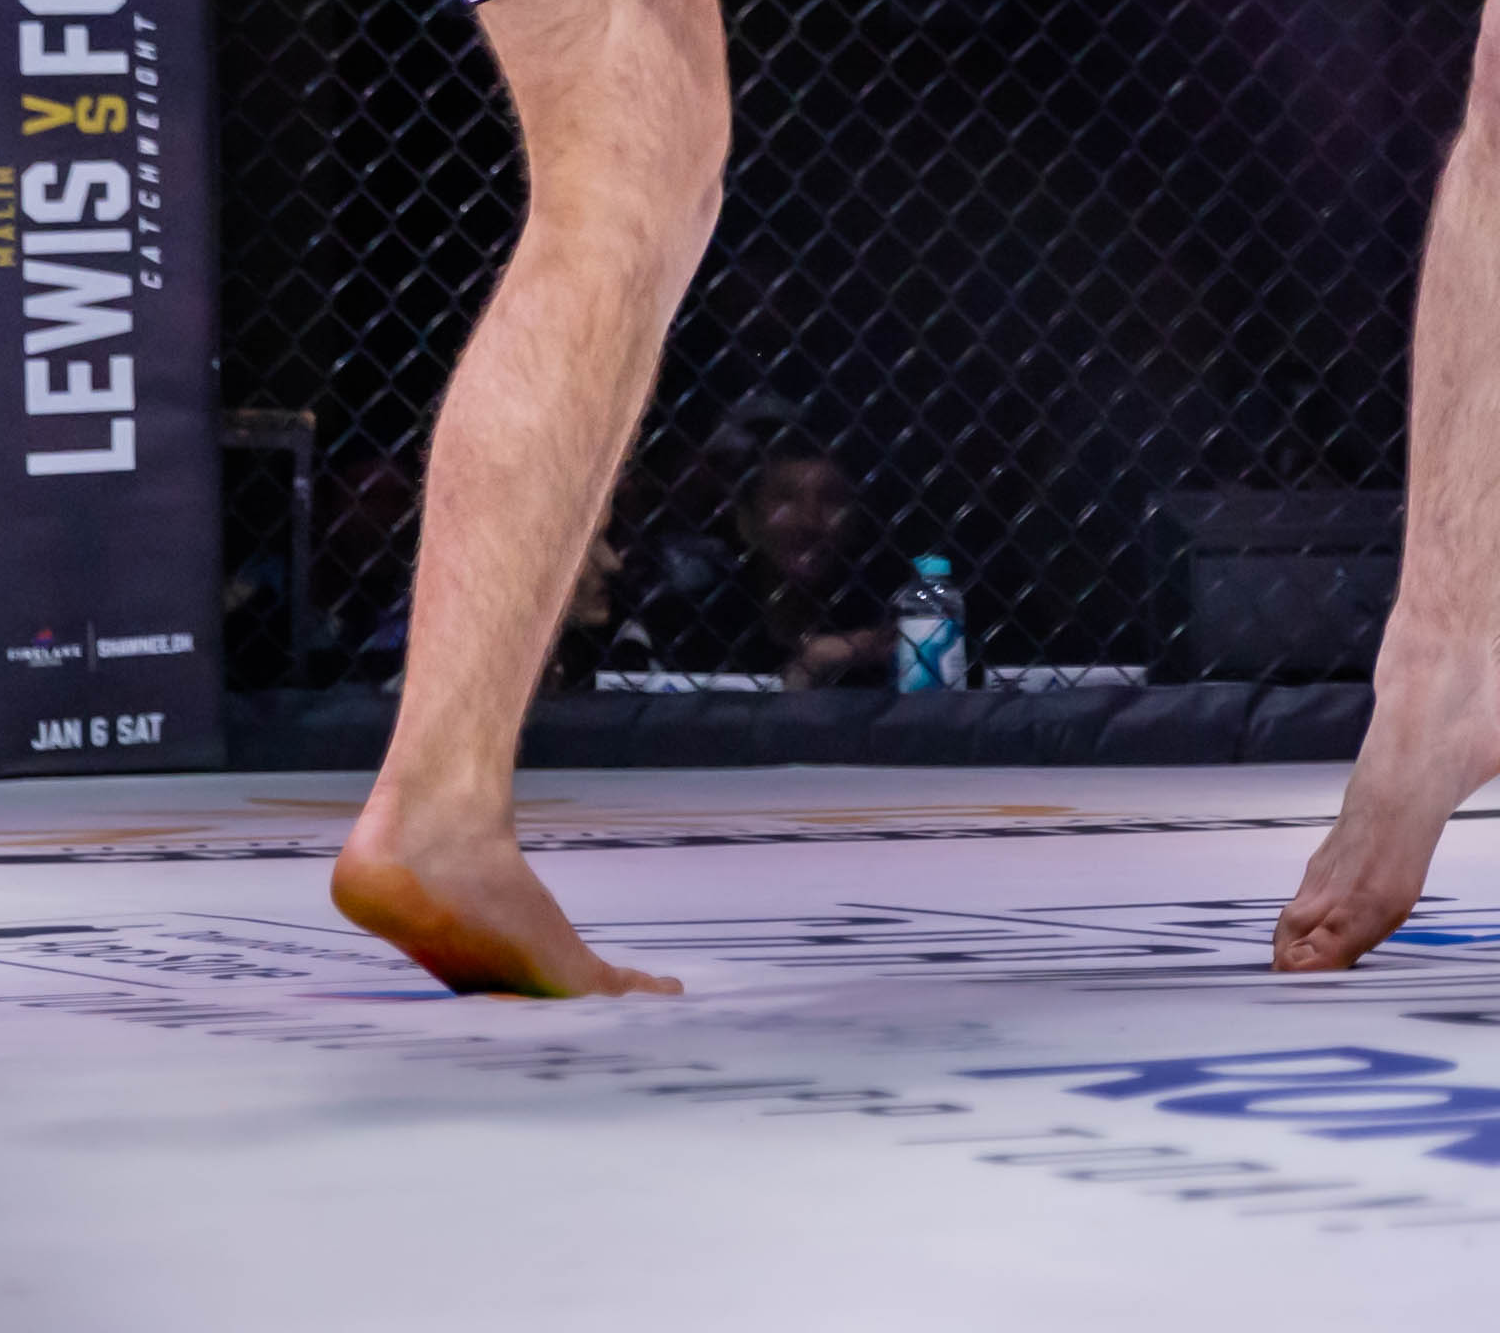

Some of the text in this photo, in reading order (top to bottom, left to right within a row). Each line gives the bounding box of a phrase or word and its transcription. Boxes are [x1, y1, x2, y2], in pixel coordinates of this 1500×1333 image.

[132, 10, 165, 292] CATCHWEIGHT
[19, 157, 137, 477] LEWIS
[30, 711, 167, 752] JAN 6 SAT
[134, 952, 314, 982] Store
